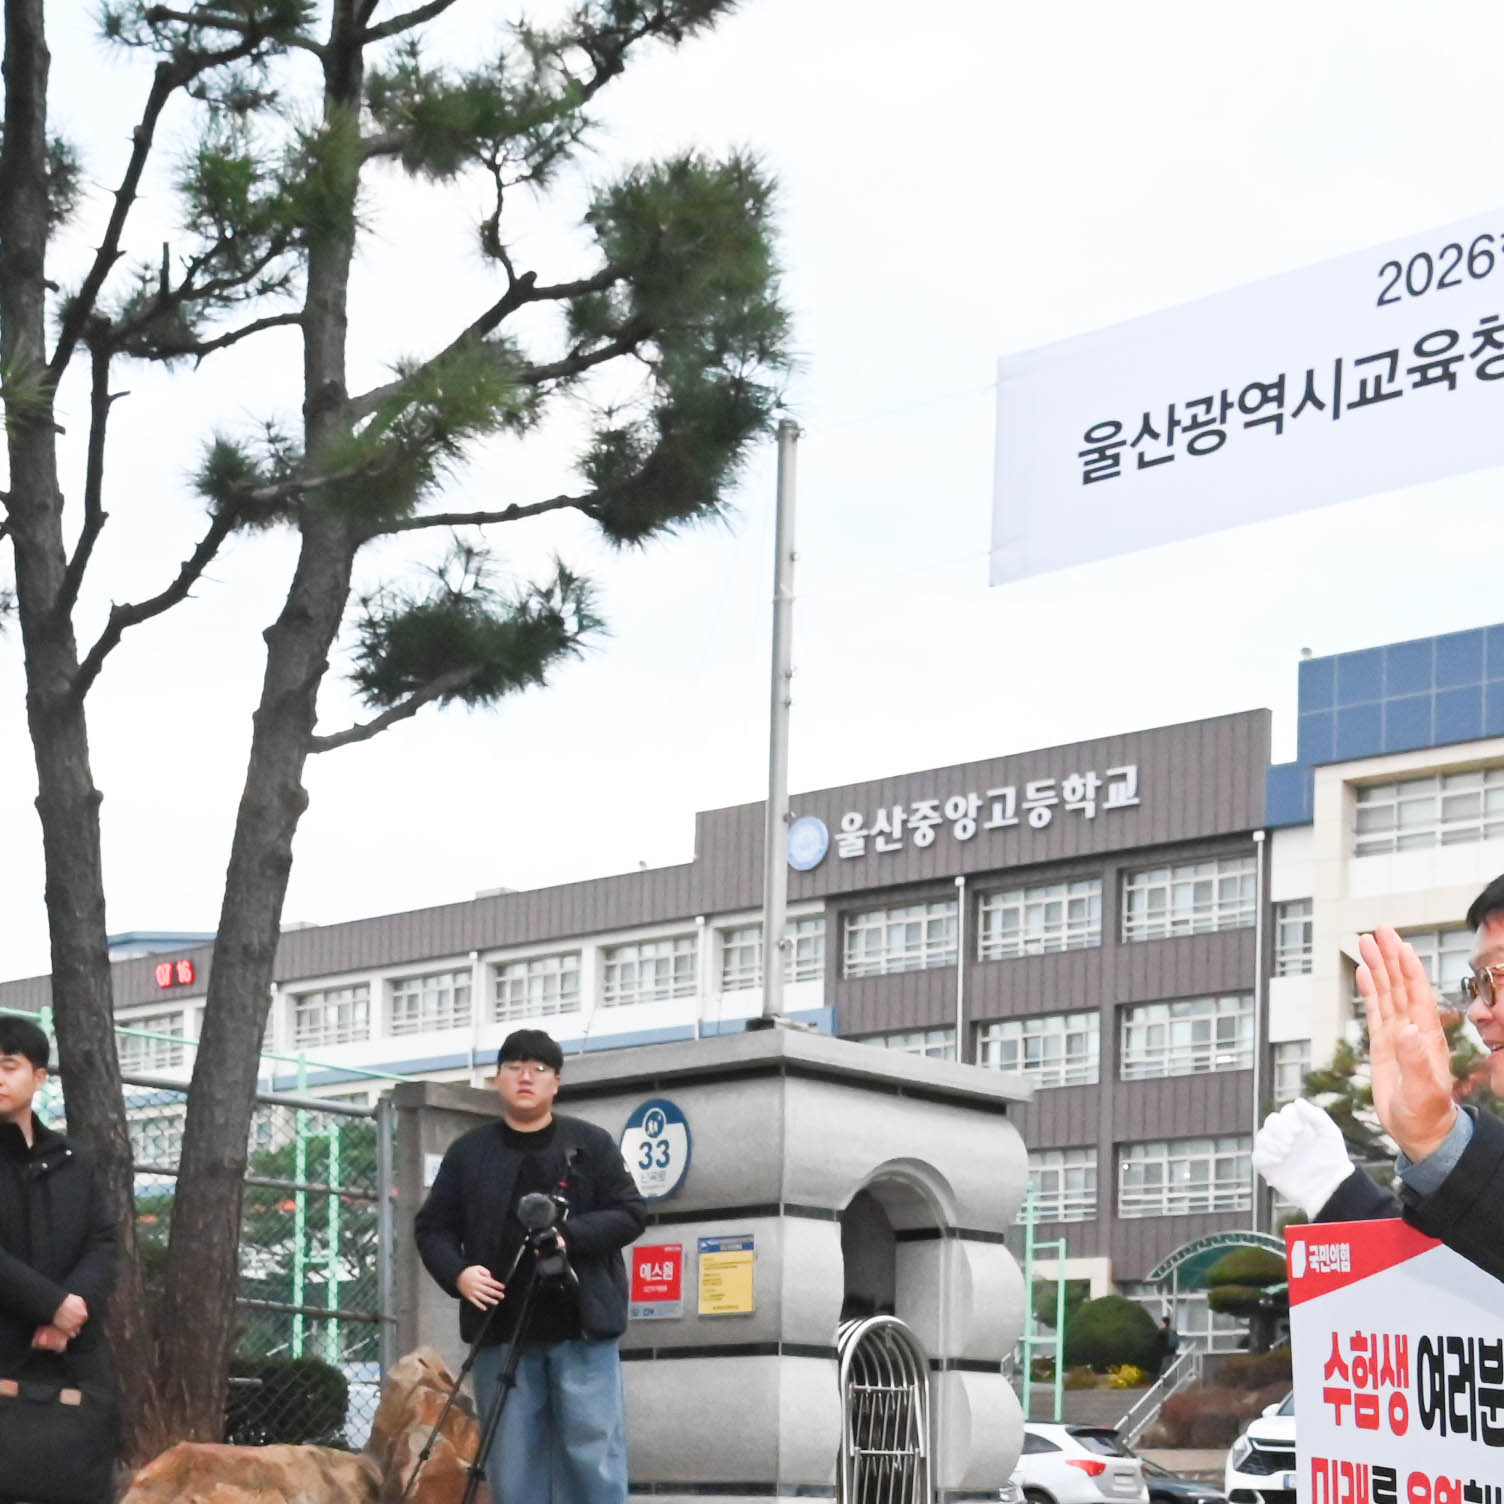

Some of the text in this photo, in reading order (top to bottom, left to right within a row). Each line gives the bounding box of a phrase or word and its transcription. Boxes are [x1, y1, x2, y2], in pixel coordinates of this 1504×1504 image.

[835, 765, 1141, 859] 울산중앙고등학교
[638, 1139, 671, 1171] 33
[1310, 1244, 1350, 1272] 국민의힘
[1324, 1331, 1408, 1436] 수험생
